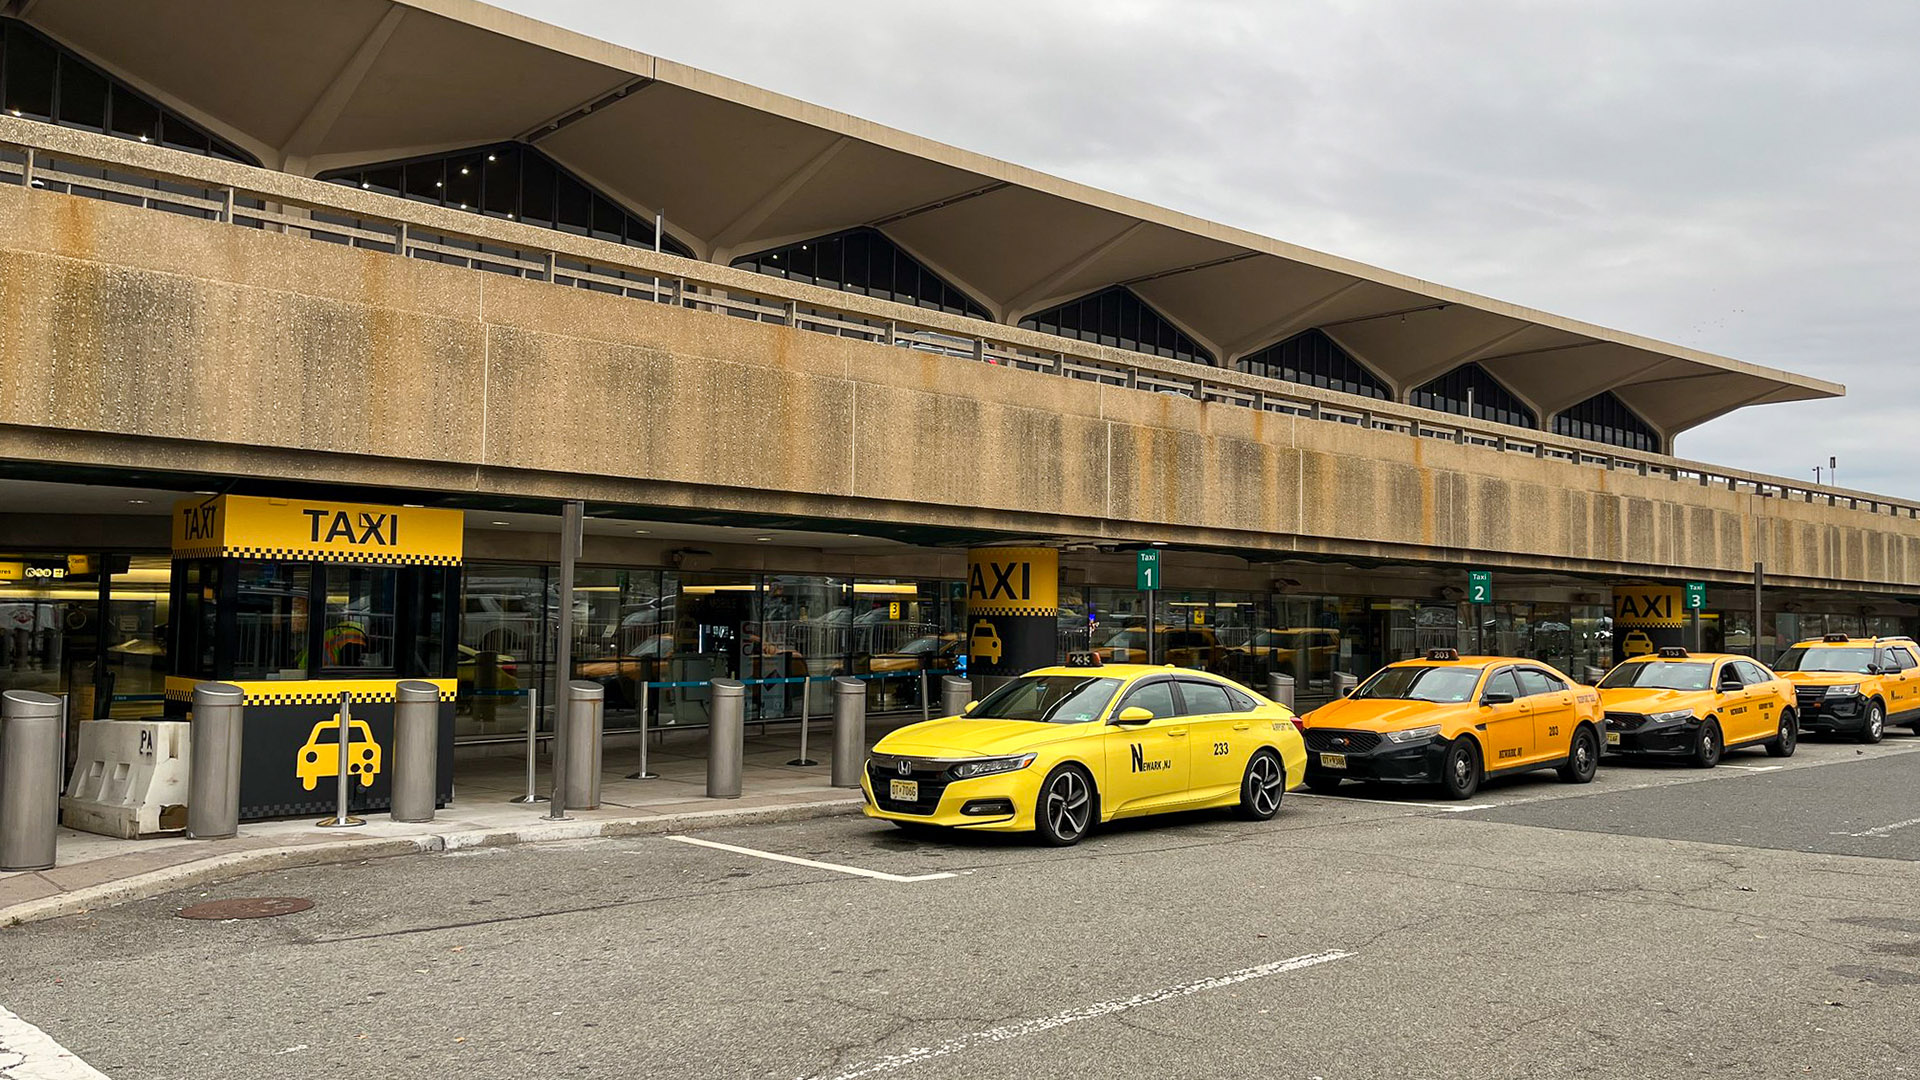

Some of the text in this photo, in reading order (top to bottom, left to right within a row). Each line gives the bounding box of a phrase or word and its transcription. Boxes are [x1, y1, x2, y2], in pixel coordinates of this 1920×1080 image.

[184, 505, 216, 540] TAXI
[303, 508, 398, 546] TAXI
[1141, 553, 1156, 562] Taxi
[968, 562, 1031, 600] AXI
[1144, 568, 1152, 587] 1
[1473, 573, 1487, 581] Taxi
[1474, 586, 1485, 601] 2
[1691, 594, 1701, 607] 3
[892, 603, 898, 614] 3
[1071, 654, 1091, 665] 233
[1434, 651, 1449, 659] 203
[1549, 725, 1559, 736] 203
[140, 730, 153, 756] PA
[1214, 742, 1229, 755] 233
